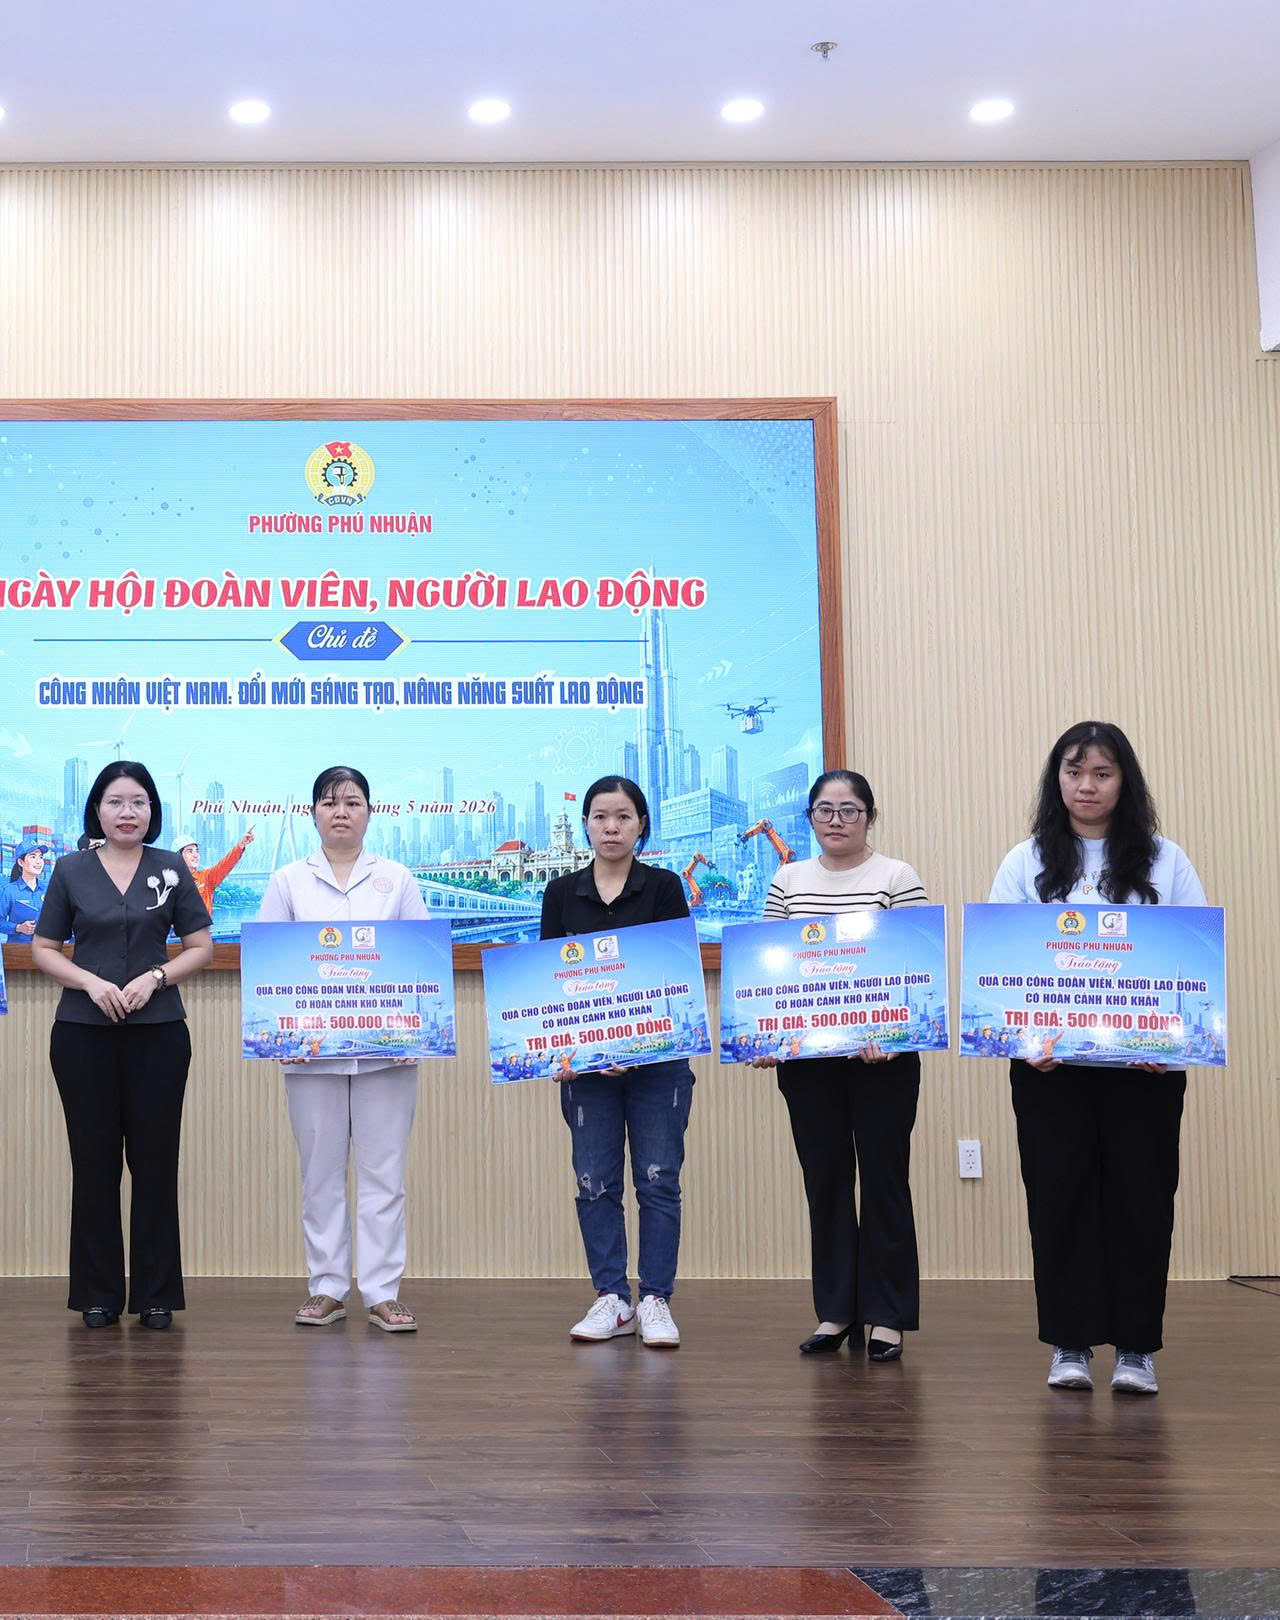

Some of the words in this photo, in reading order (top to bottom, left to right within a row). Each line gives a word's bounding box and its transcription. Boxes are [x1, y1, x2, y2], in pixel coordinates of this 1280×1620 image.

[249, 512, 321, 533] PHƯỜNG
[329, 512, 363, 533] PHÚ
[371, 512, 432, 537] NHUẬN
[89, 571, 153, 615] HỘI
[163, 571, 271, 608] ĐOÀN
[280, 571, 379, 611] VIÊN,
[388, 570, 507, 608] NGƯỜI
[516, 579, 589, 608] LAO
[597, 570, 705, 614] ĐỘNG
[307, 624, 347, 649] Chủ
[352, 626, 379, 649] đề
[39, 677, 86, 705] CÔNG
[92, 677, 140, 705] NHÂN
[146, 677, 180, 710] VIỆT
[186, 681, 232, 705] NAM:
[238, 671, 266, 705] ĐỔI
[272, 678, 305, 705] MỚI
[311, 677, 358, 705] SÁNG
[363, 681, 400, 710] TẠO,
[404, 677, 452, 705] NÂNG
[458, 677, 507, 705] NĂNG
[511, 674, 554, 705] SUẤT
[560, 681, 590, 705] LAO
[597, 677, 643, 710] ĐỘNG
[192, 800, 222, 814] Phú
[229, 800, 285, 816] Nhuận,
[406, 801, 414, 814] 5
[420, 801, 453, 814] năm
[459, 800, 496, 814] 2026
[276, 986, 293, 995] CHO
[398, 985, 413, 994] LAO
[755, 987, 772, 997] CHO
[884, 976, 901, 986] LAO
[1002, 977, 1022, 987] CHO
[1154, 981, 1173, 990] LAO
[521, 1007, 539, 1018] CHO
[646, 988, 662, 999] LAO
[330, 1016, 382, 1029] 500.000
[811, 1011, 867, 1028] 500.000
[1067, 1012, 1135, 1029] 500.000
[579, 1026, 632, 1045] 500.000
